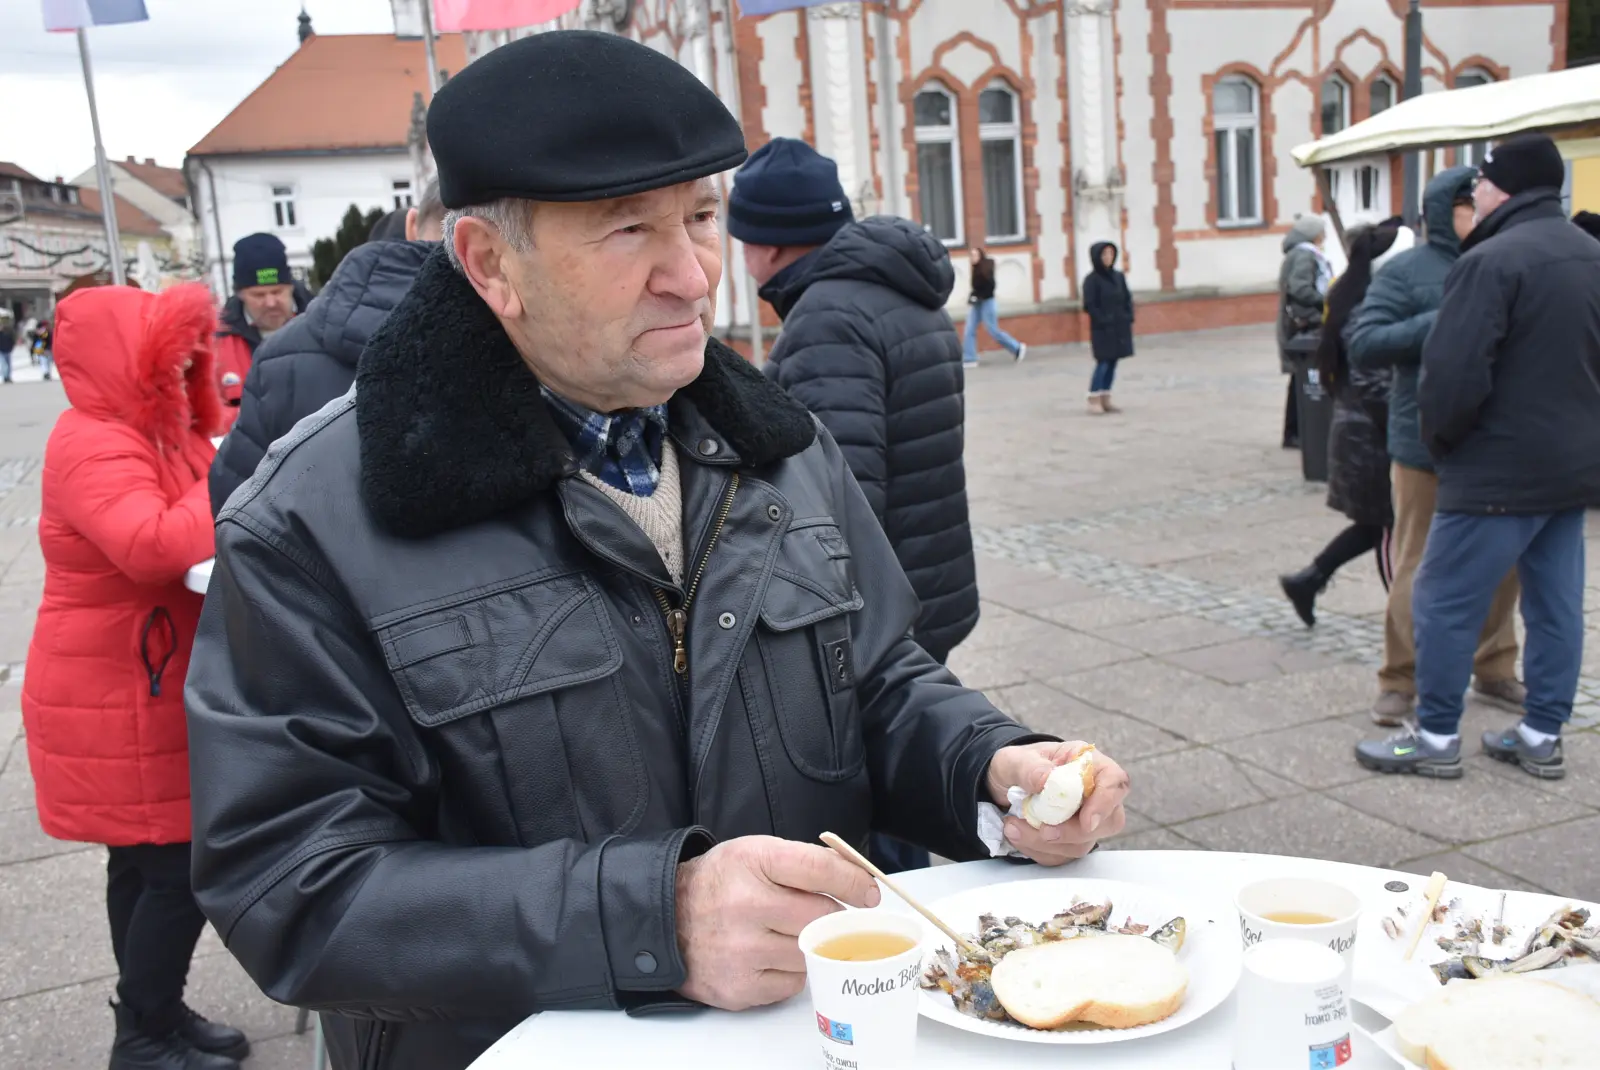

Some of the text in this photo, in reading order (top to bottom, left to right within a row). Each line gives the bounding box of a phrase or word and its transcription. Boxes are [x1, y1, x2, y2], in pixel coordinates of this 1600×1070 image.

[842, 977, 897, 997] Mocha
[1304, 1013, 1331, 1026] away
[836, 1057, 858, 1070] away
